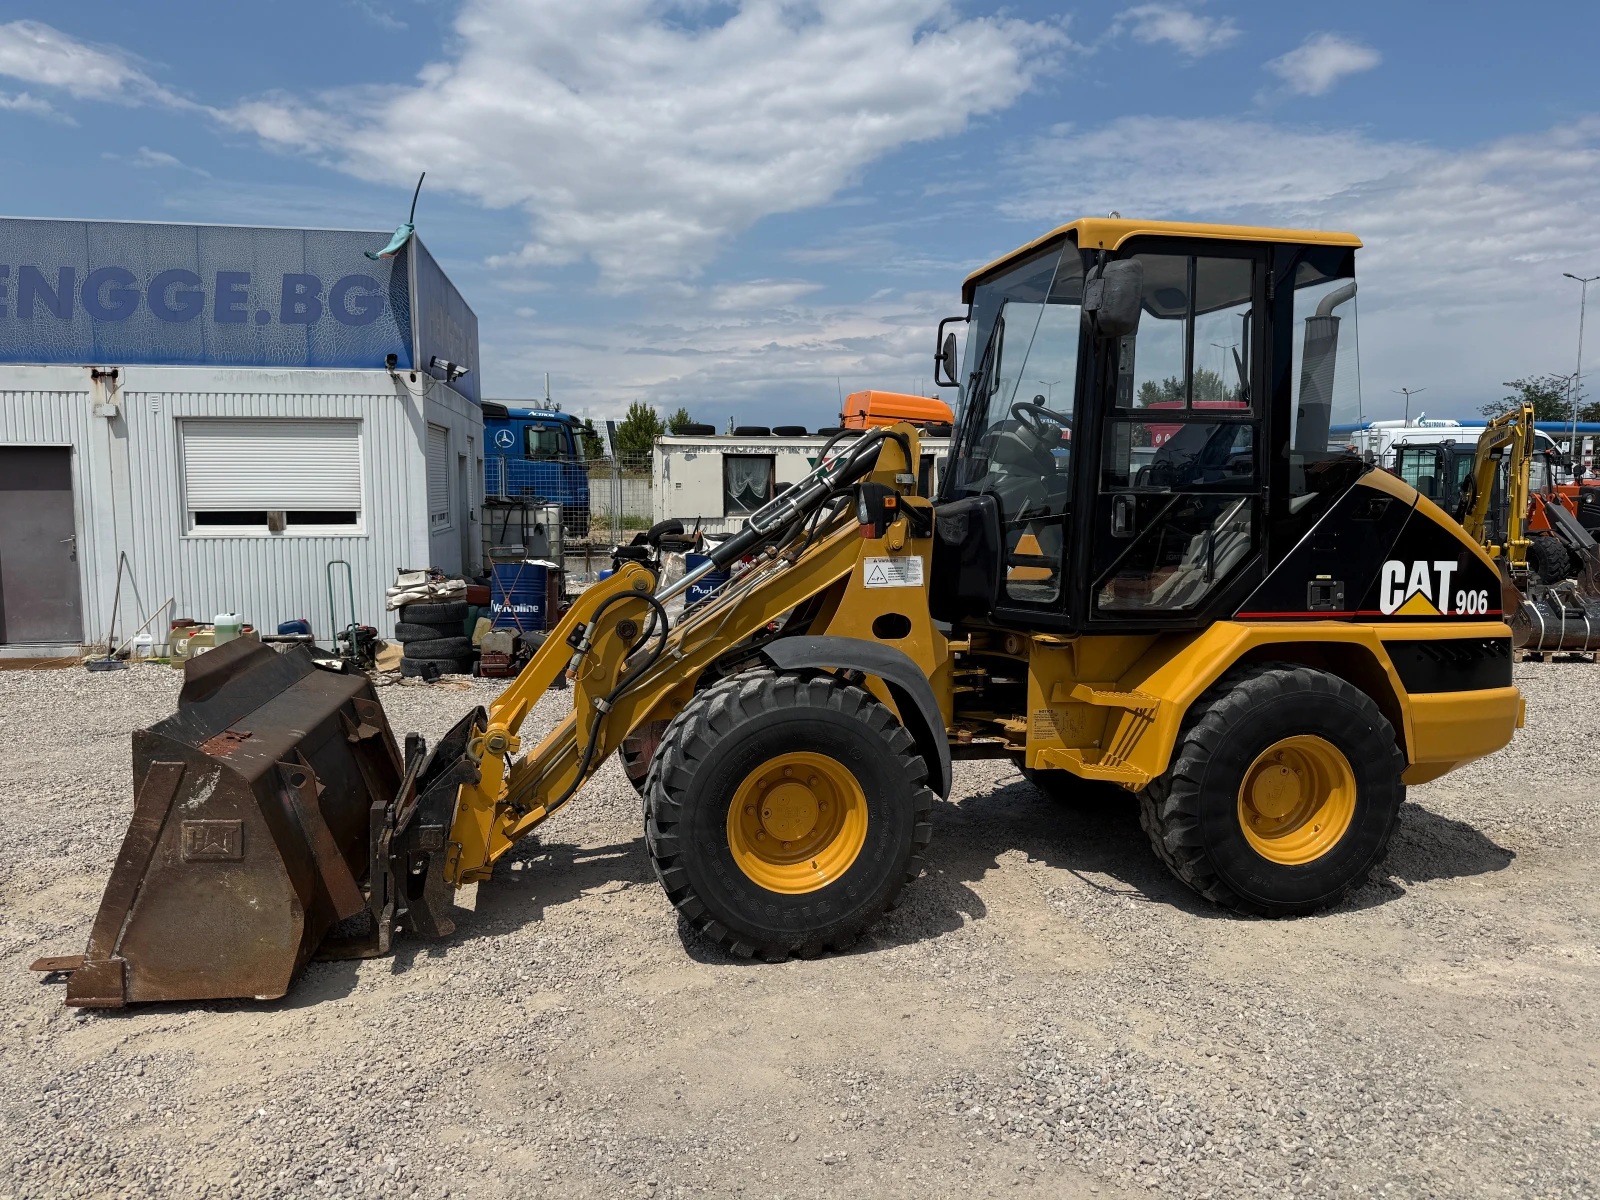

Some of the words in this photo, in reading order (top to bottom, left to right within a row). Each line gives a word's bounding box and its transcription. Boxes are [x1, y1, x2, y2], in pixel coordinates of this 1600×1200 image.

[0, 265, 385, 327] NGGE.BG
[1380, 560, 1458, 615] CAT
[1455, 590, 1488, 615] 906
